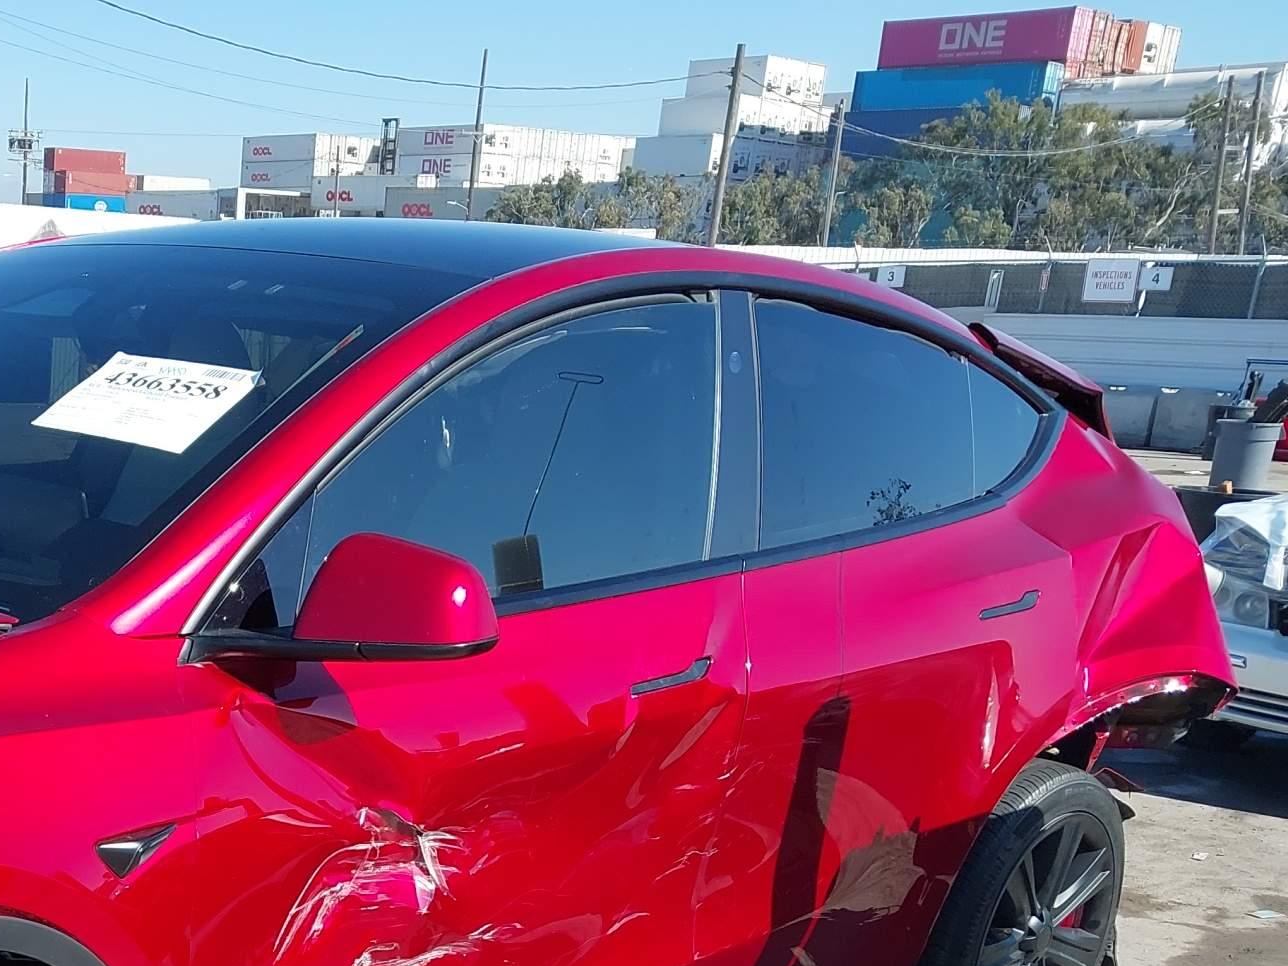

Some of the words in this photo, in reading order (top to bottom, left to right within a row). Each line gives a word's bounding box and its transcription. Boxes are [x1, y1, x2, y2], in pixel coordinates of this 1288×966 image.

[938, 19, 1008, 50] ONE
[424, 129, 454, 145] ONE
[252, 147, 272, 156] OOCL
[422, 159, 451, 174] ONE
[326, 190, 353, 202] OOCL
[138, 204, 163, 216] OOCL
[401, 203, 433, 217] OOCL
[888, 271, 895, 282] 3
[1091, 270, 1132, 280] INSPECTIONS
[1151, 273, 1160, 285] 4
[1095, 281, 1125, 290] VEHICLES
[104, 371, 228, 400] 43663558
